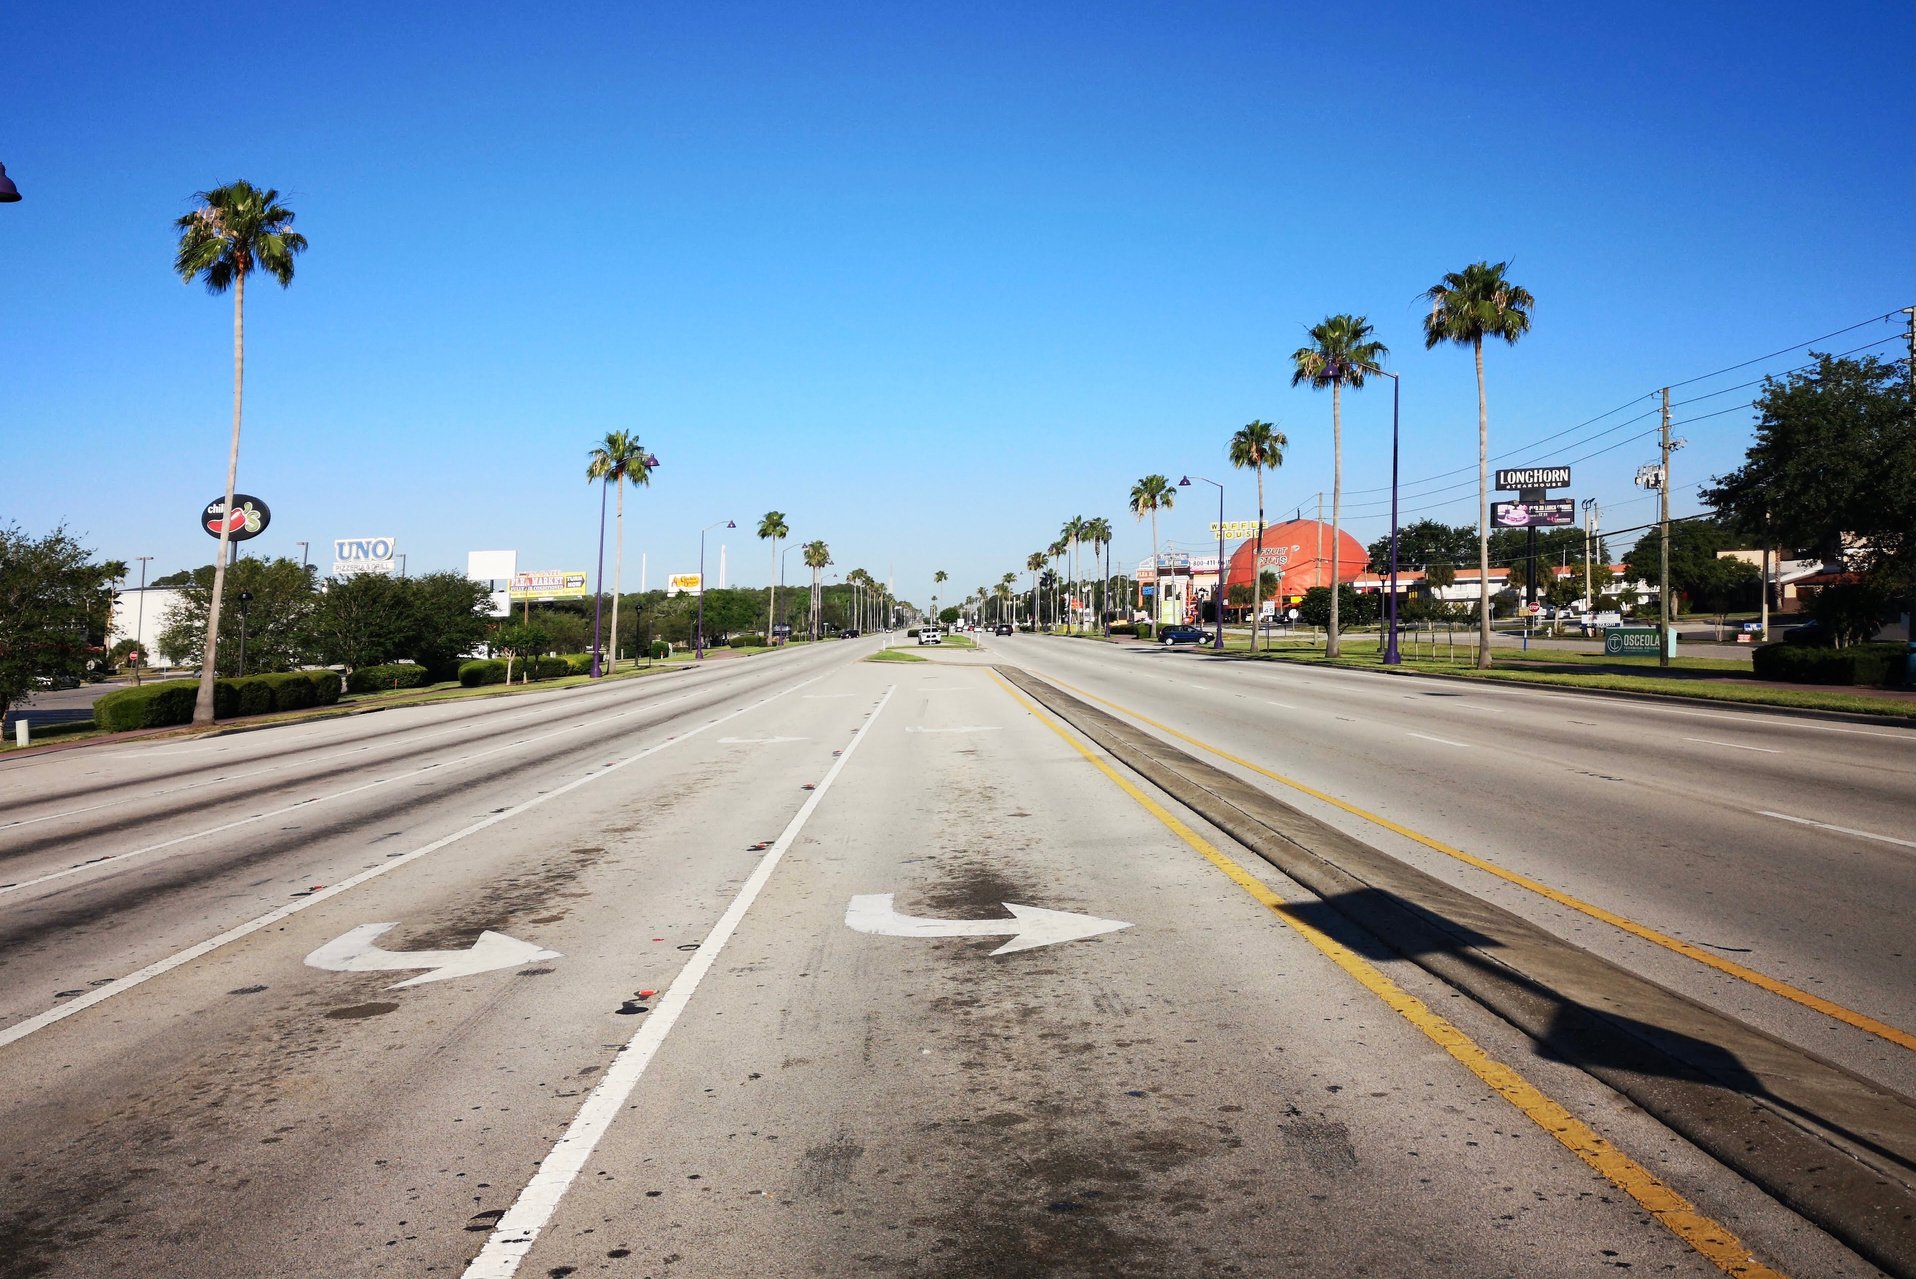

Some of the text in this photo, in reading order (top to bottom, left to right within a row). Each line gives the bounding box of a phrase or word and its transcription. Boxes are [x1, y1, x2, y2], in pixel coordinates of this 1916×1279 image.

[1500, 469, 1569, 485] LONGHORN
[336, 539, 390, 561] UNO
[532, 576, 563, 585] MARKET
[1623, 634, 1661, 647] OSCEOLA
